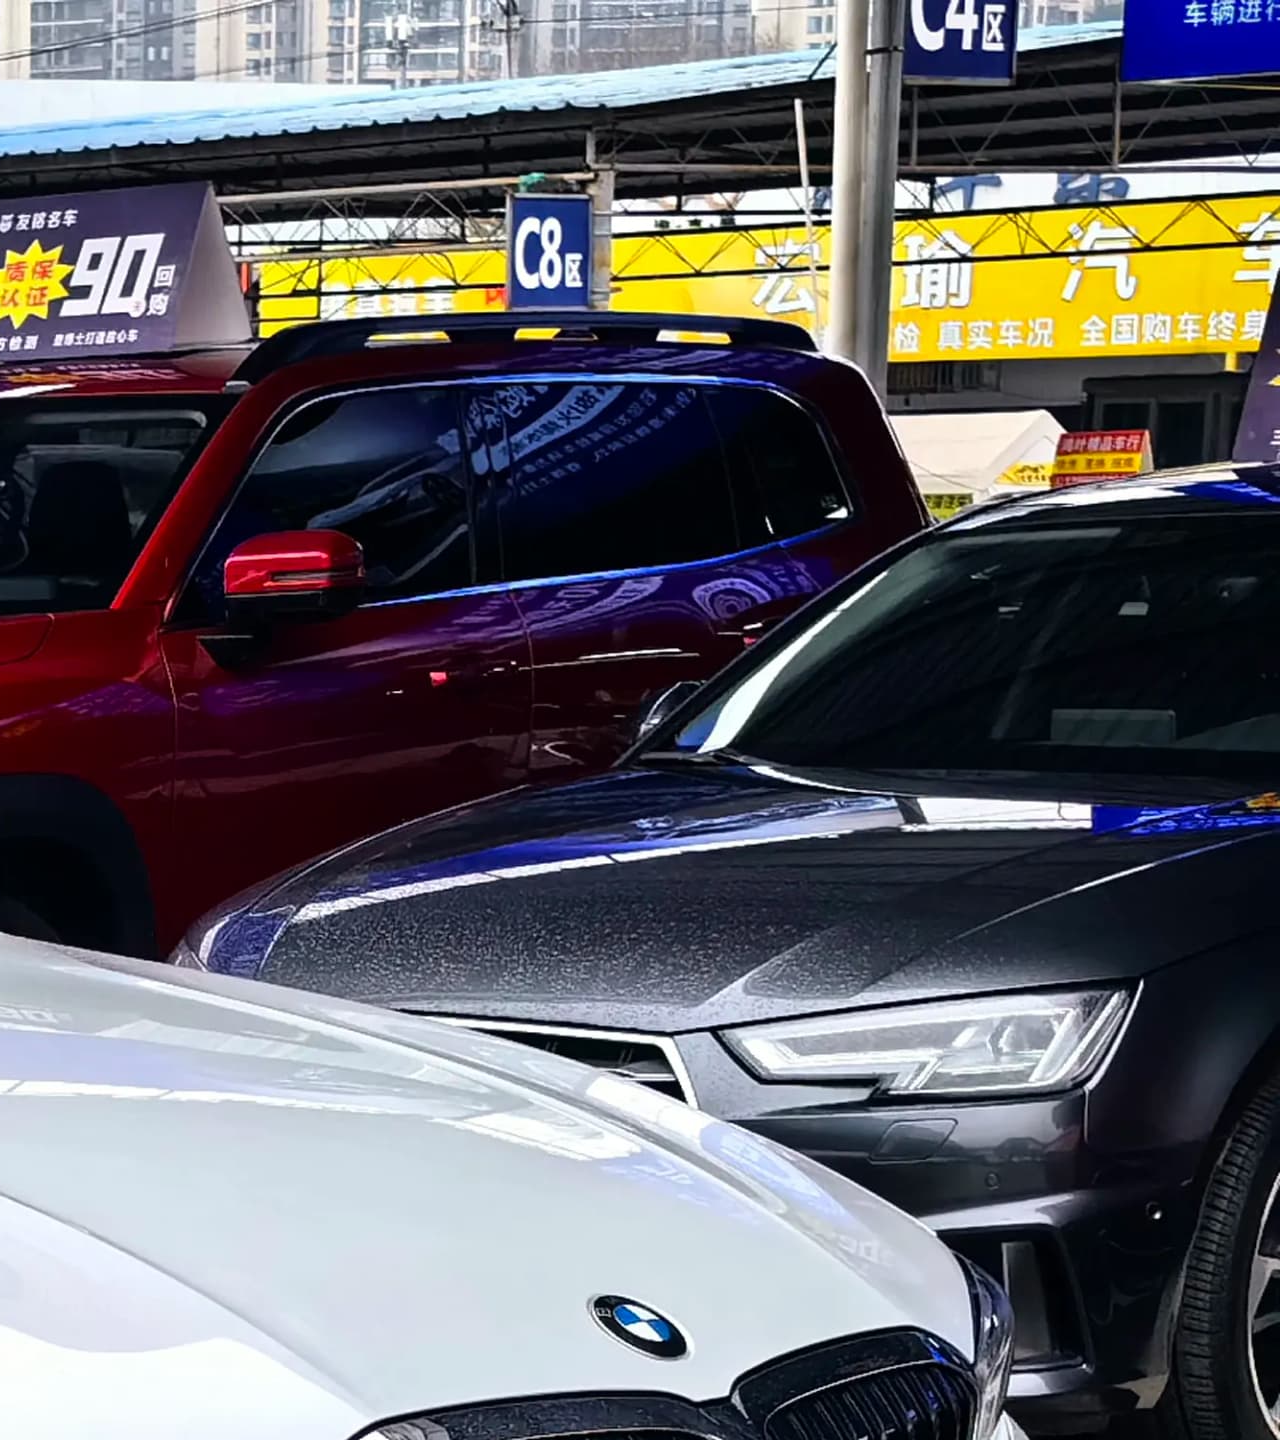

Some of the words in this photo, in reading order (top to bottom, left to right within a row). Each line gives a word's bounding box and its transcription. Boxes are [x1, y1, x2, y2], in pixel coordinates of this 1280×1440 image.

[515, 216, 583, 289] C8区
[937, 317, 1055, 350] 真实车况
